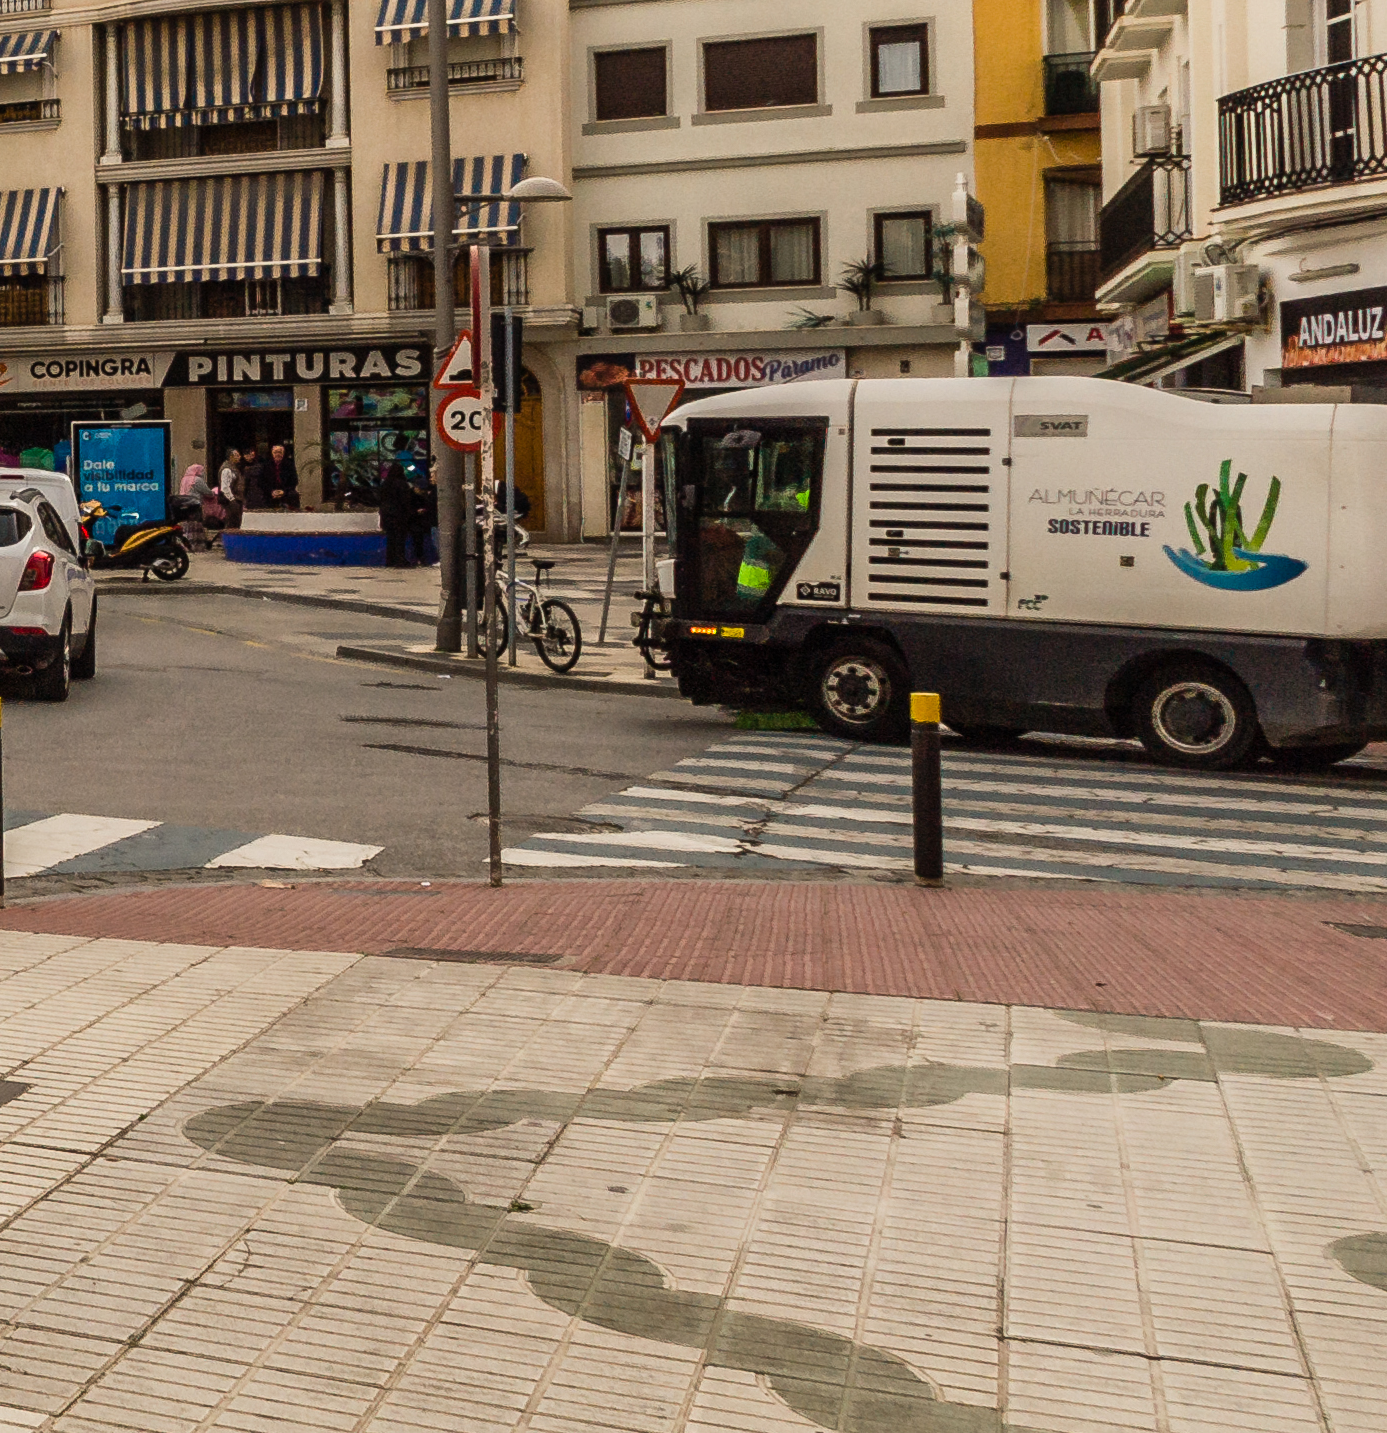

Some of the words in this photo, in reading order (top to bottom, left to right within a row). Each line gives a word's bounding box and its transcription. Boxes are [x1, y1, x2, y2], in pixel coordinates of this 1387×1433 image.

[30, 357, 152, 380] COPINGRA
[188, 349, 422, 382] PINTURAS
[637, 355, 764, 383] PESCADOS
[1039, 421, 1083, 431] SVAT
[83, 459, 115, 471] Dale
[84, 470, 154, 481] visibilidad
[84, 484, 93, 493] a
[97, 482, 110, 493] tu
[115, 482, 159, 492] marca
[1028, 487, 1166, 507] ALMUÑÉCAR
[1069, 507, 1084, 516] LA
[1088, 508, 1166, 518] HERRADURA
